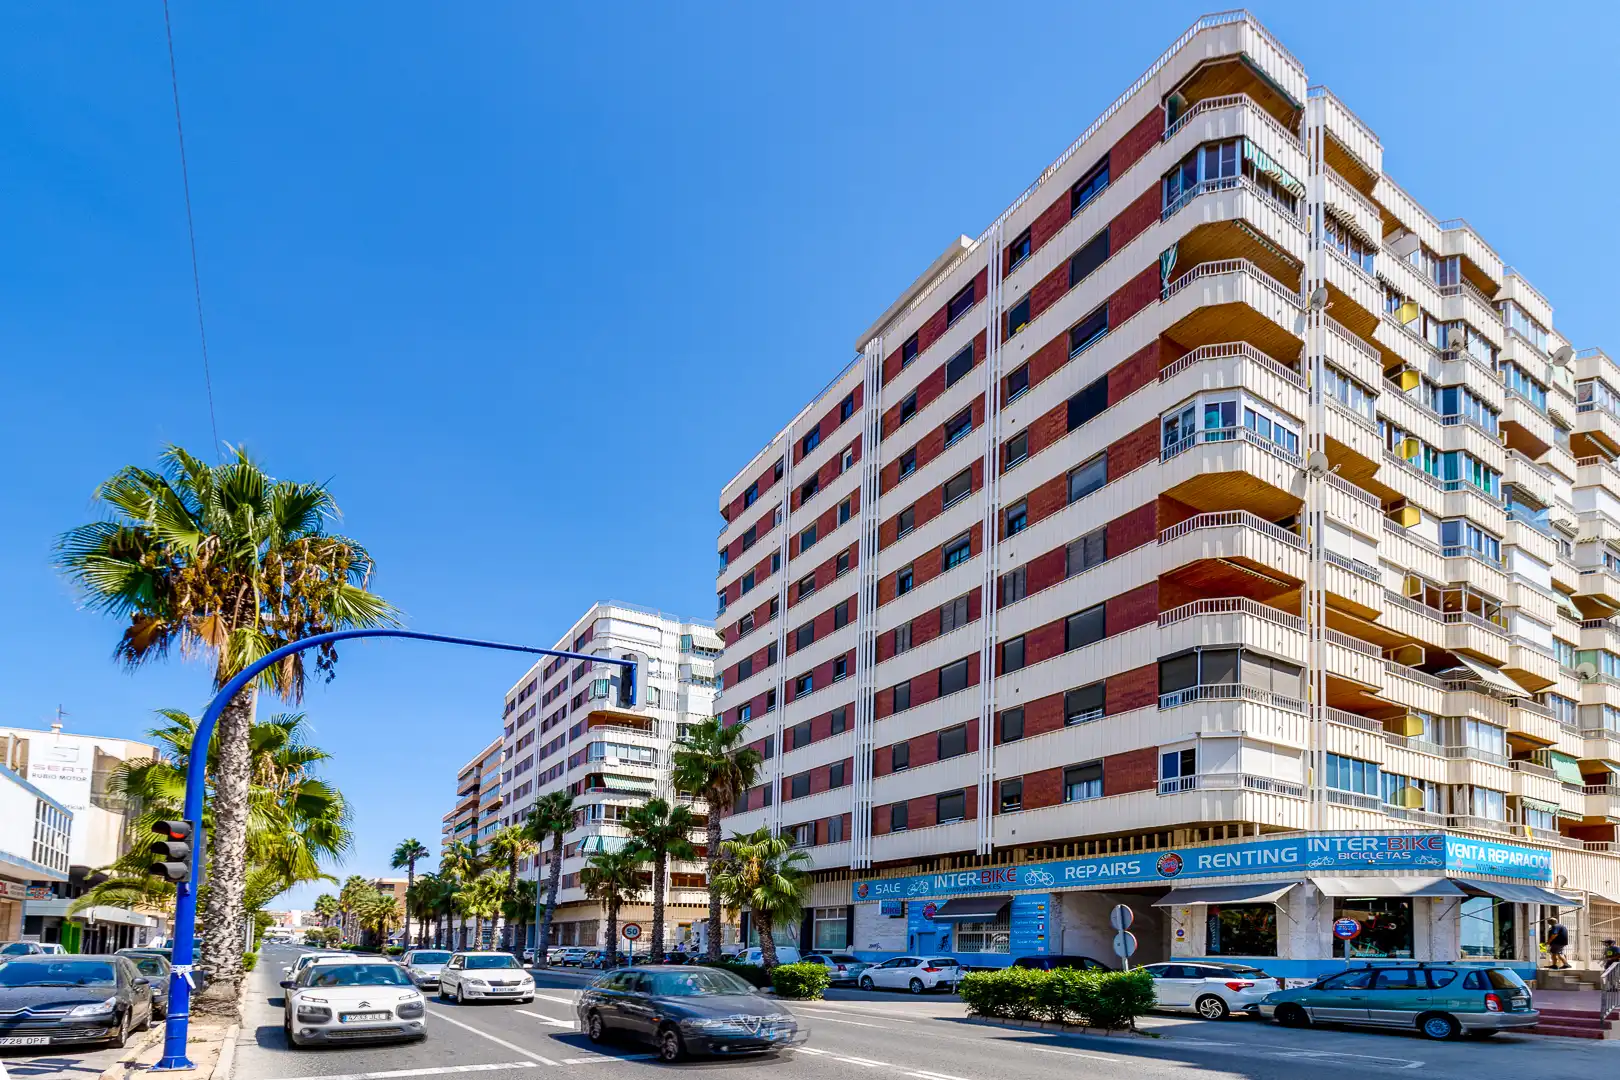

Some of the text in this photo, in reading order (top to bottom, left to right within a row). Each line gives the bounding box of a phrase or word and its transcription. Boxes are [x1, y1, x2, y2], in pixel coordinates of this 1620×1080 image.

[33, 764, 88, 773] SEAT
[1308, 837, 1443, 851] INTER-BIKE
[1198, 847, 1298, 869] RENTING
[1338, 852, 1412, 860] BICICLETAS
[1446, 841, 1486, 862] VENTA
[1064, 860, 1141, 880] REPAIRS
[934, 868, 1017, 888] INTER-BIKE
[875, 882, 901, 895] SALE
[626, 927, 638, 936] 50
